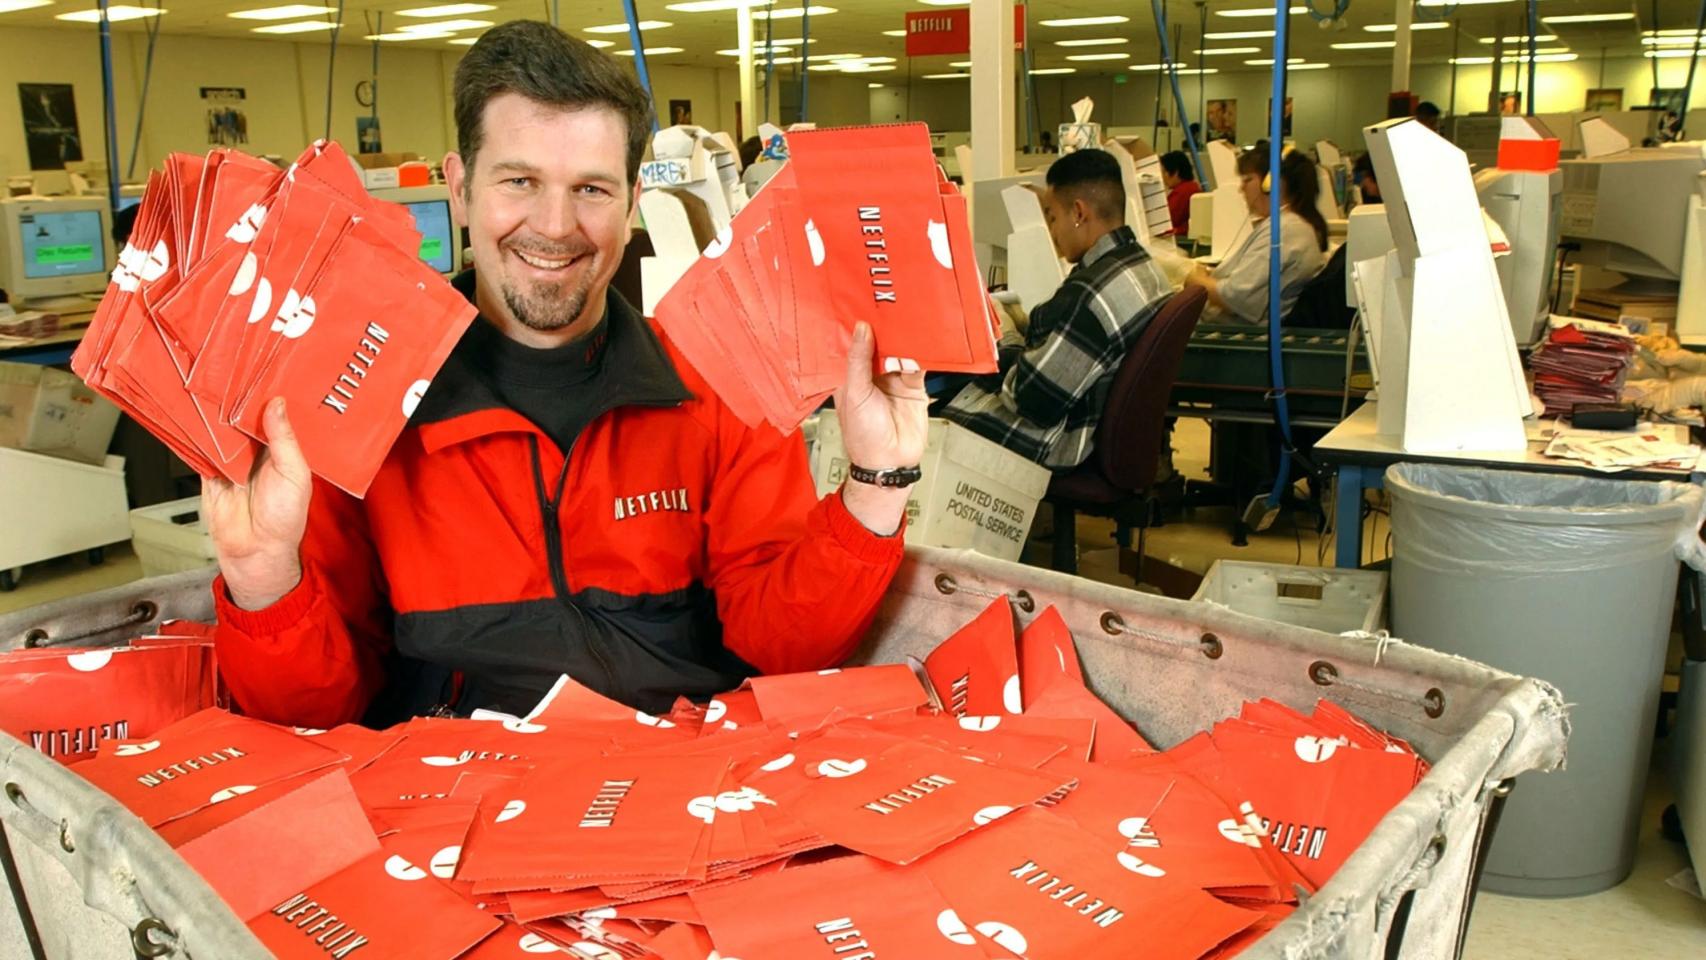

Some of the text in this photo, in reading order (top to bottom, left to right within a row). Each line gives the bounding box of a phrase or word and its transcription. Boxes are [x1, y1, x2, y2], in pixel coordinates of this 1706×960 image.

[910, 17, 953, 33] NETFLIX
[858, 206, 897, 303] NETFLIX
[321, 321, 390, 415] NETFLIX
[614, 487, 689, 521] NETFLIX
[946, 498, 1022, 543] POSTAL SERVICE
[955, 480, 1025, 524] UNITED STATES
[30, 720, 129, 757] NETFLIX
[137, 747, 248, 788] NETFLIX
[578, 778, 638, 829] NETFLIX
[864, 773, 956, 815] NETFLIX
[1008, 860, 1124, 928] NETFLIX
[271, 893, 369, 960] NETFLIX
